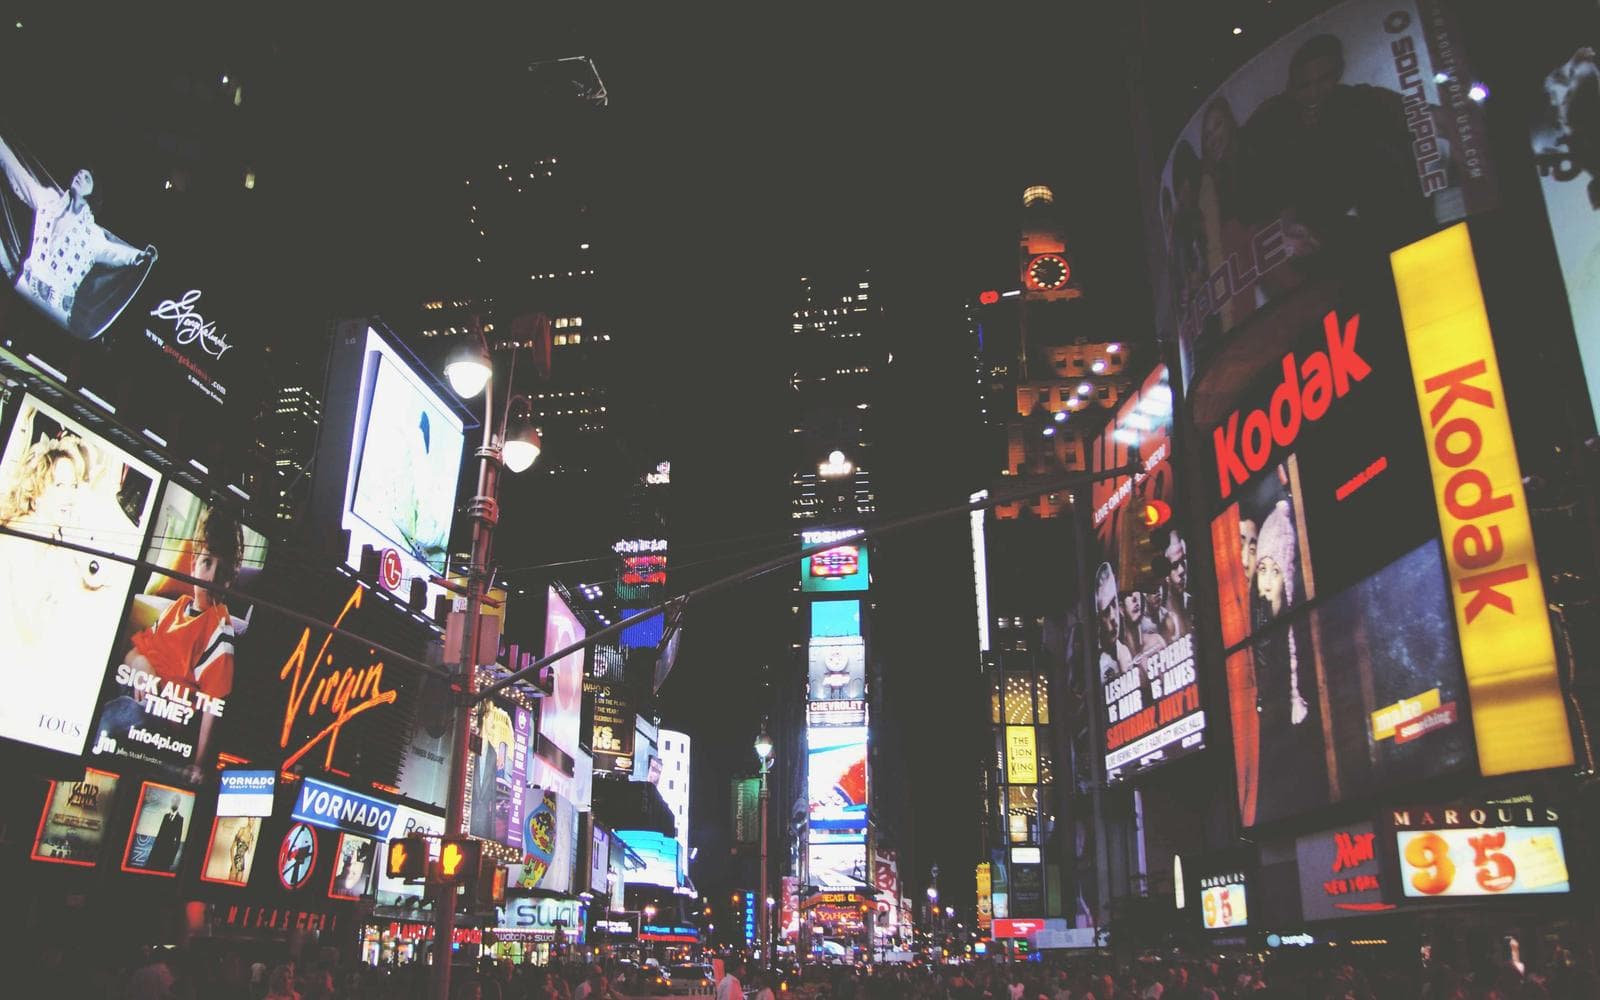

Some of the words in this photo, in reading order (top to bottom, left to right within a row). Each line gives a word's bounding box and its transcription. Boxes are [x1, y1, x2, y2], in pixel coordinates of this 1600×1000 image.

[1391, 35, 1449, 198] SOUTHPOLE
[1213, 309, 1372, 499] Kodak
[1423, 358, 1529, 625] Kodak
[115, 664, 163, 697] SICK
[160, 680, 193, 708] ALL
[195, 691, 226, 718] THE
[280, 584, 397, 770] Virgin
[143, 693, 194, 726] TIME?
[810, 701, 864, 713] CHEVROLET
[37, 714, 83, 738] TOUS
[127, 725, 193, 758] info4pi.org
[1011, 744, 1033, 761] LION
[1013, 736, 1030, 745] THE
[221, 776, 275, 786] VORNADO
[1011, 762, 1034, 776] KING
[302, 786, 392, 832] VORNADO
[1393, 807, 1560, 826] MARQUIS
[1200, 873, 1246, 888] MARQUIS
